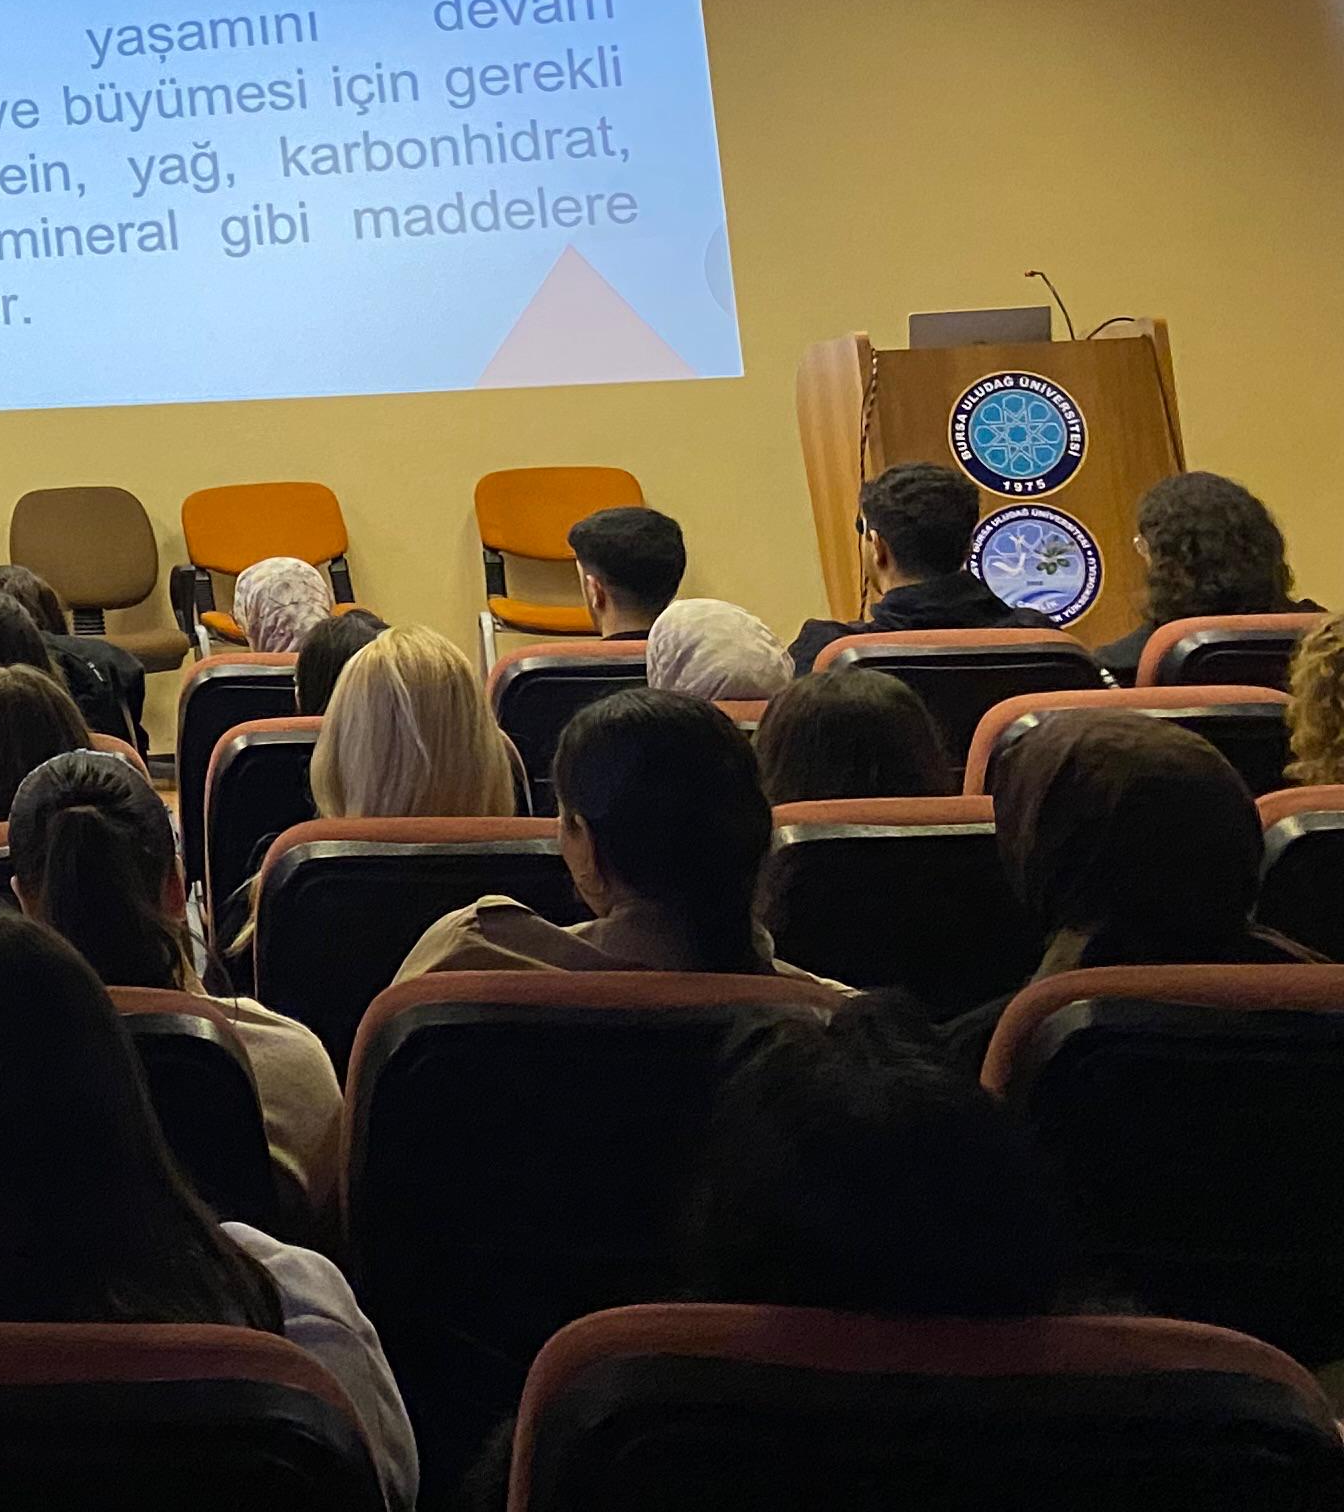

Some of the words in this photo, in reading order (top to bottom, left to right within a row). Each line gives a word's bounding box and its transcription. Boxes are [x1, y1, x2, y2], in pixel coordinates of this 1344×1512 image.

[86, 10, 319, 70] yaşamını
[63, 68, 308, 132] büyümesi
[331, 62, 419, 116] için
[445, 44, 623, 109] gerekli
[127, 140, 235, 197] yağ,
[279, 117, 630, 178] karbonhidrat,
[220, 200, 310, 257] gibi
[353, 186, 639, 239] maddelere
[961, 376, 1014, 411] ULUDAĞ
[1019, 376, 1082, 457] ÜNİVERSİTESİ
[954, 414, 973, 461] BURSA
[1003, 478, 1046, 492] 1975
